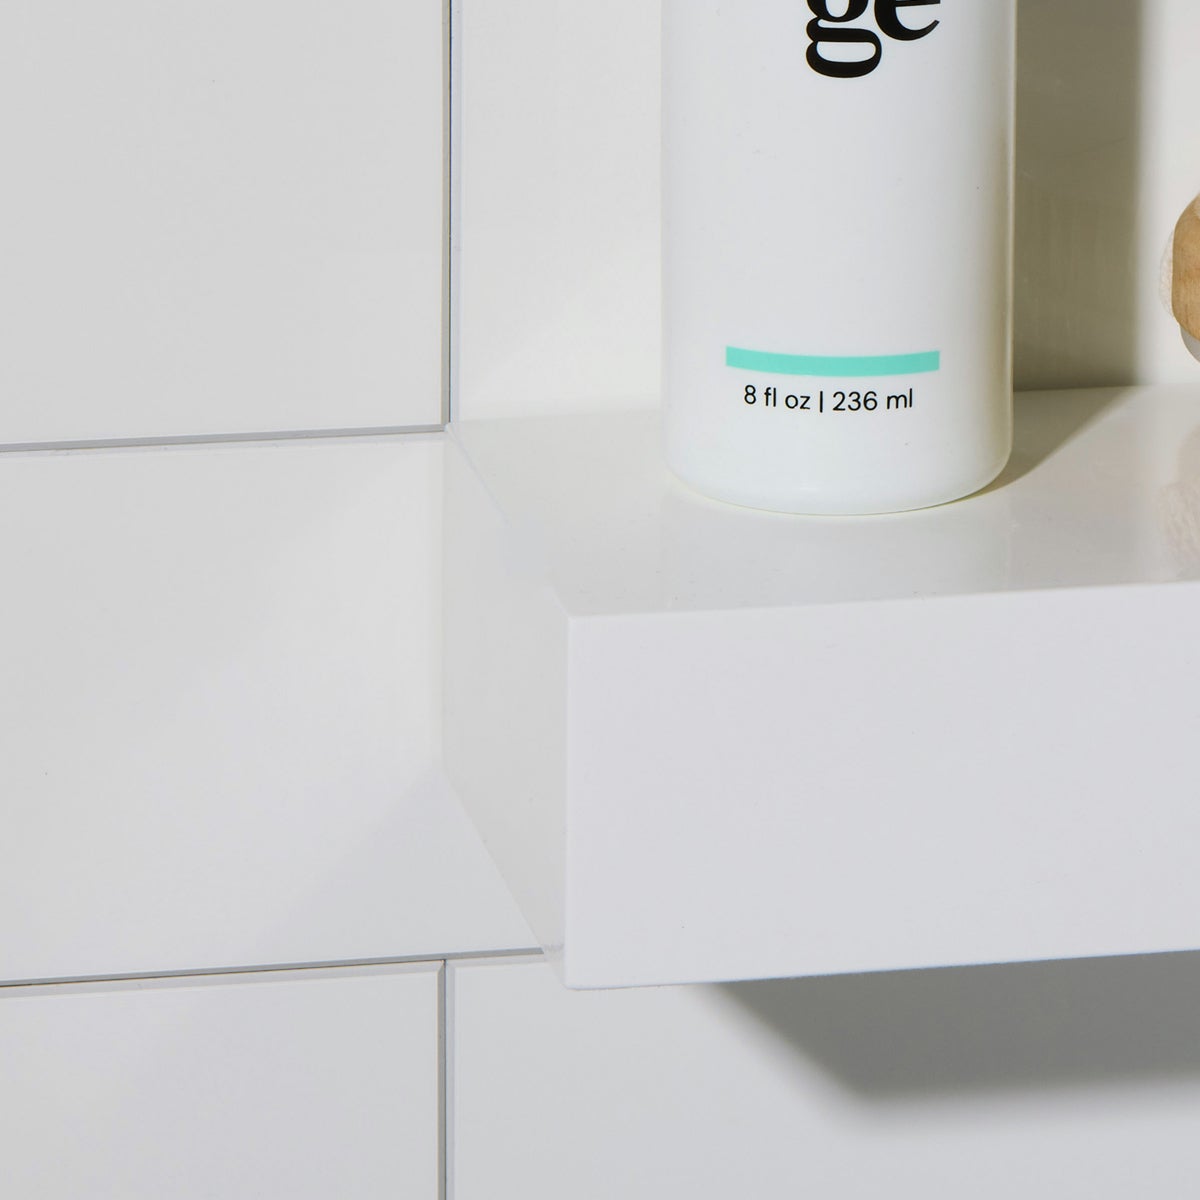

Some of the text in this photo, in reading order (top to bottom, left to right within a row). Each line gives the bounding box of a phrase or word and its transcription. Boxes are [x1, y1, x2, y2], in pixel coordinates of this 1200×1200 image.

[743, 384, 757, 405] 8
[763, 386, 777, 408] fl
[784, 394, 811, 410] oz
[832, 390, 878, 412] 236
[886, 387, 913, 410] ml
